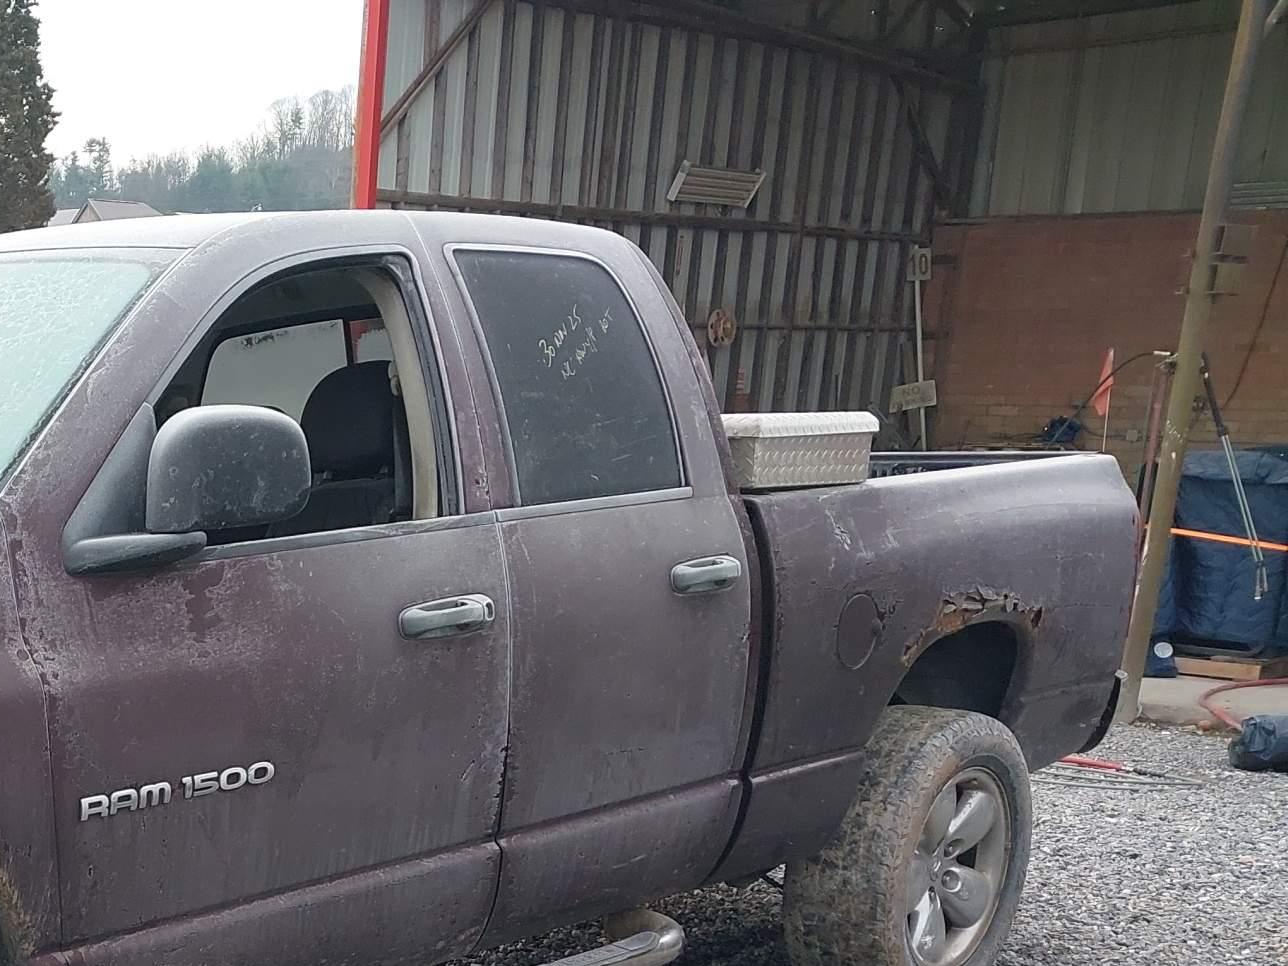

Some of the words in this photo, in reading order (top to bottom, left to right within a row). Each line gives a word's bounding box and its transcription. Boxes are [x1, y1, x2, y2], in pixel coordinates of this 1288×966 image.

[909, 252, 929, 276] 10
[80, 781, 172, 822] RAM
[181, 760, 276, 799] 1500
